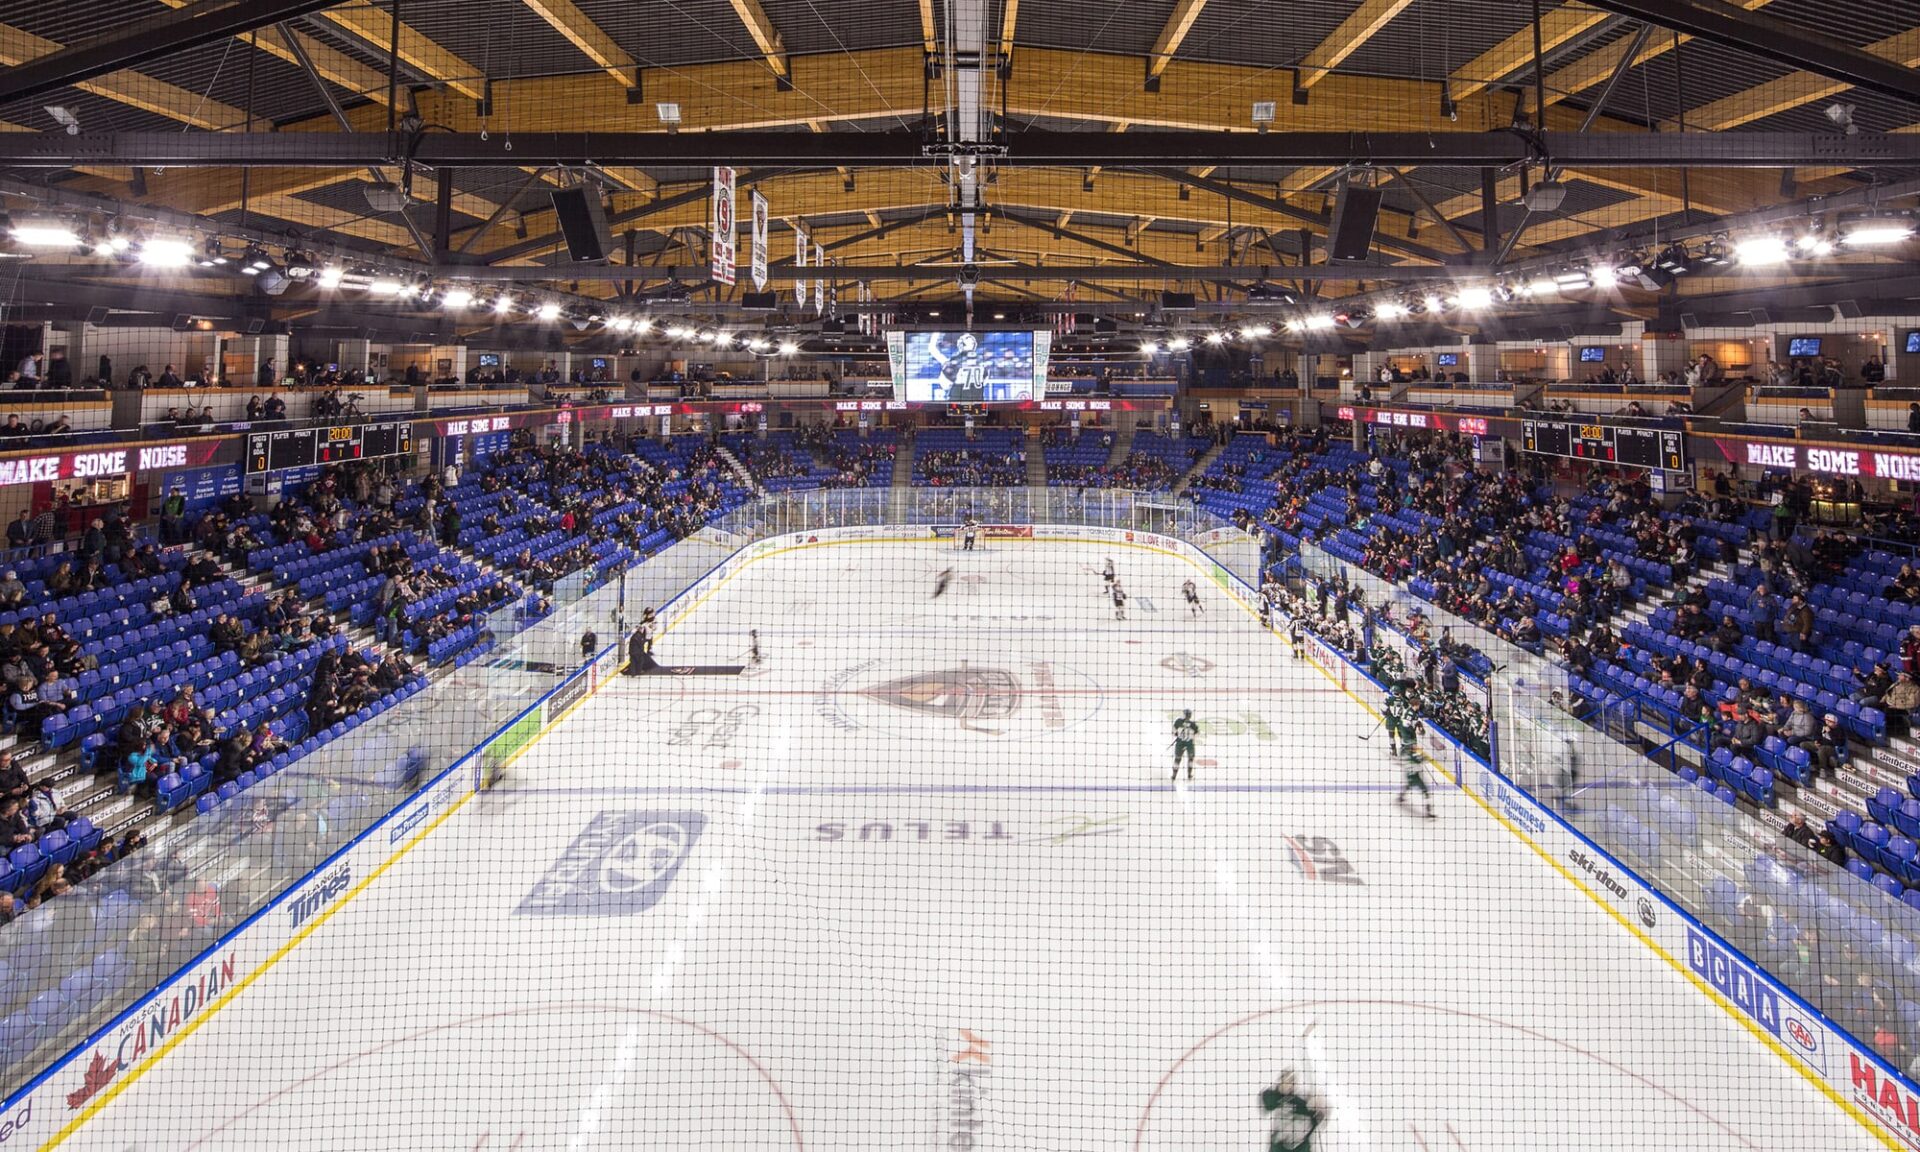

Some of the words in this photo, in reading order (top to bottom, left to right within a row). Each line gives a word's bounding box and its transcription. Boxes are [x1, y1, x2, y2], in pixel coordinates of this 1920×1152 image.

[963, 366, 984, 391] 70
[612, 408, 631, 417] MAKE
[634, 406, 651, 416] SOME
[655, 405, 672, 415] NOISE
[837, 402, 857, 410] MAKE
[861, 402, 881, 410] SOME
[447, 421, 468, 435] MAKE
[471, 419, 489, 433] SOME
[493, 417, 510, 430] NOISE
[1377, 411, 1392, 423] MAKE
[1393, 413, 1408, 426] SOME
[329, 427, 352, 440] 20:00
[1581, 425, 1602, 438] 20:00
[323, 449, 330, 461] 0
[354, 445, 360, 457] 0
[1577, 443, 1583, 456] 0
[1607, 448, 1613, 460] 0
[1671, 455, 1678, 468] 0
[1747, 444, 1796, 468] MAKE
[1807, 449, 1860, 474] SOME
[0, 457, 60, 485] MAKE
[73, 451, 126, 477] SOME
[139, 445, 187, 470] NOISE
[258, 457, 265, 470] 0
[1498, 783, 1546, 834] Wawanesa
[815, 823, 1013, 841] TELUS
[305, 858, 351, 898] LANGLEY
[1568, 849, 1628, 900] ski-doo
[287, 867, 351, 930] Times
[1692, 936, 1775, 1027] BCAA
[118, 953, 236, 1071] CANADIAN
[120, 998, 162, 1037] MOLSON
[1789, 1020, 1813, 1048] CAA
